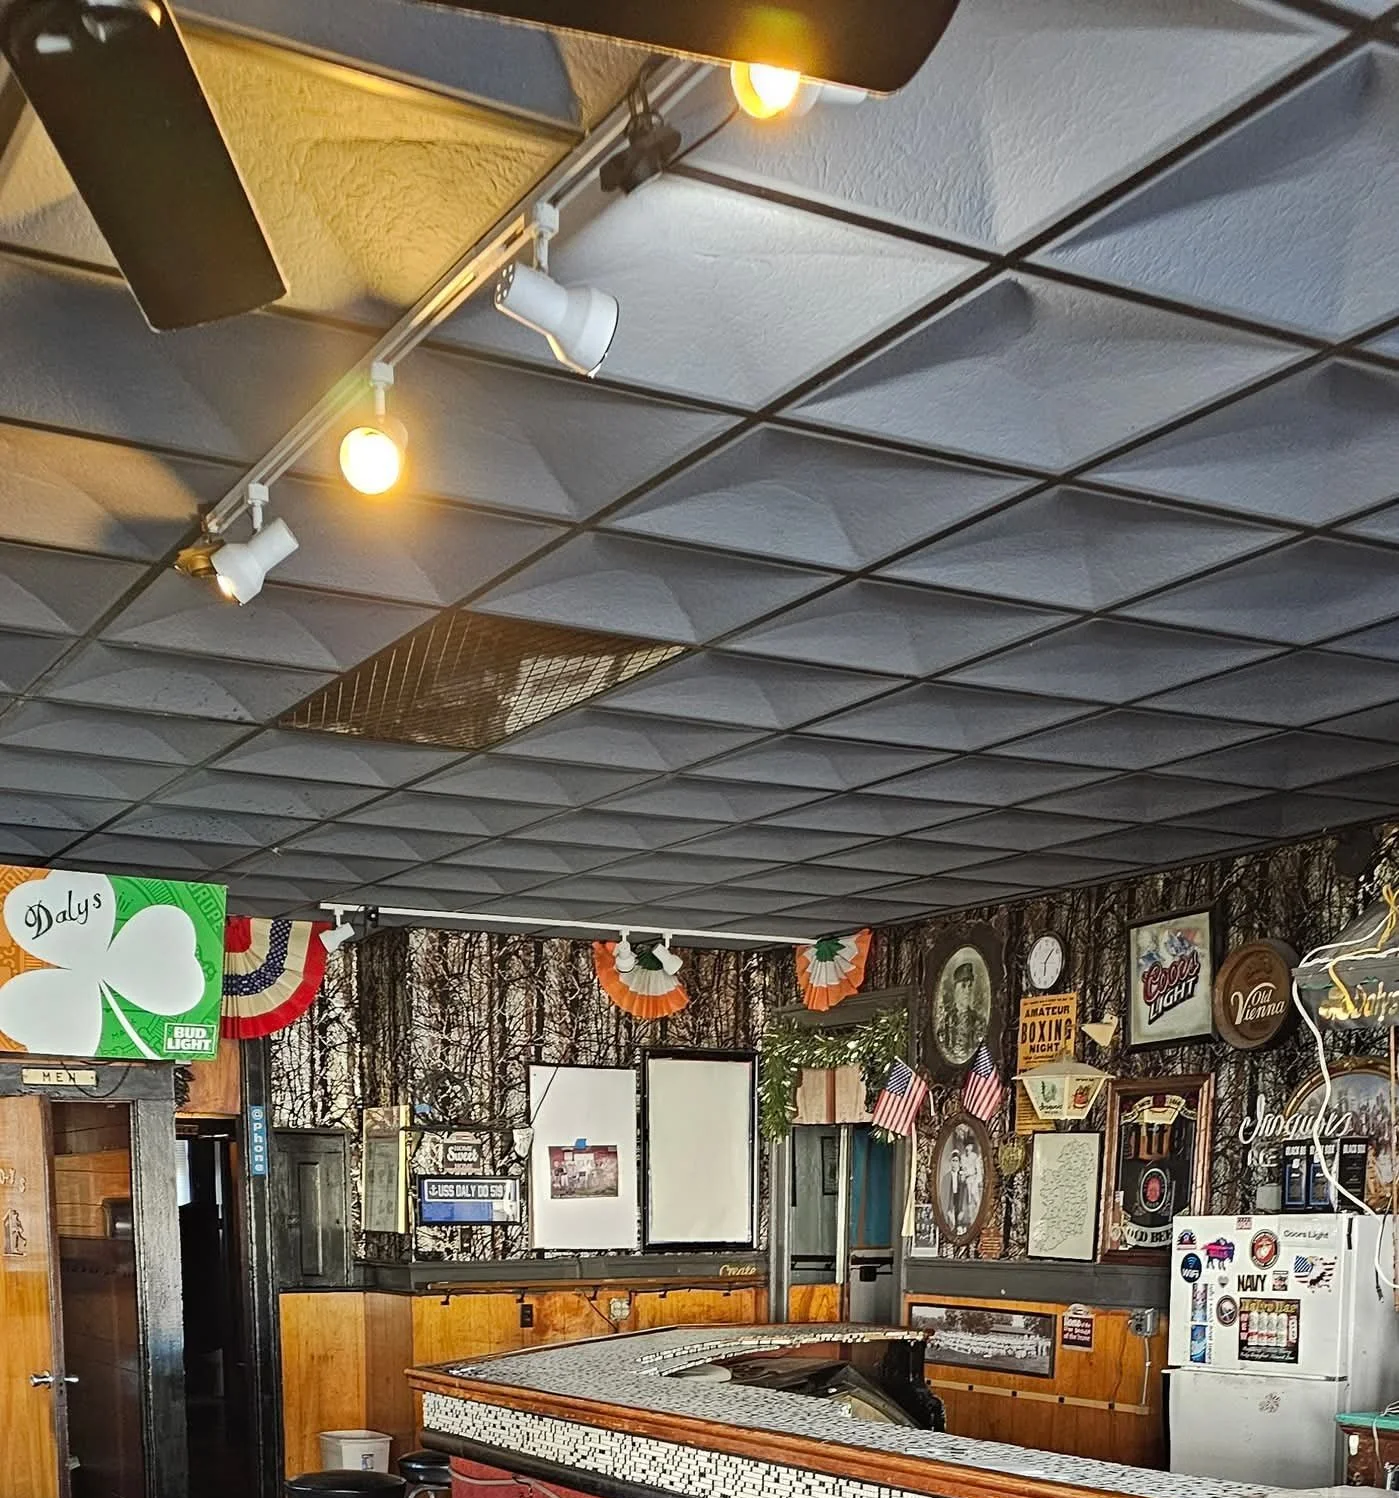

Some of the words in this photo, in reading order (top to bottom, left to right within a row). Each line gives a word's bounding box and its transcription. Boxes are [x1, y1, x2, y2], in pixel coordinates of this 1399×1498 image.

[25, 890, 102, 940] Dalys
[1142, 950, 1201, 1006] Coors
[1149, 976, 1199, 1022] LIGHT
[1231, 983, 1286, 1025] Vienna
[1251, 989, 1272, 1006] Old
[1025, 1005, 1070, 1018] AMATEUR
[174, 1027, 207, 1039] BUD
[1021, 1018, 1072, 1044] BOXING
[167, 1038, 212, 1050] LIGHT
[1029, 1043, 1060, 1053] NIGHT
[42, 1071, 76, 1082] MEN
[447, 1146, 479, 1161] Sweet
[438, 1184, 454, 1197] USS
[455, 1184, 476, 1197] DALY
[1238, 1274, 1266, 1292] NAVY
